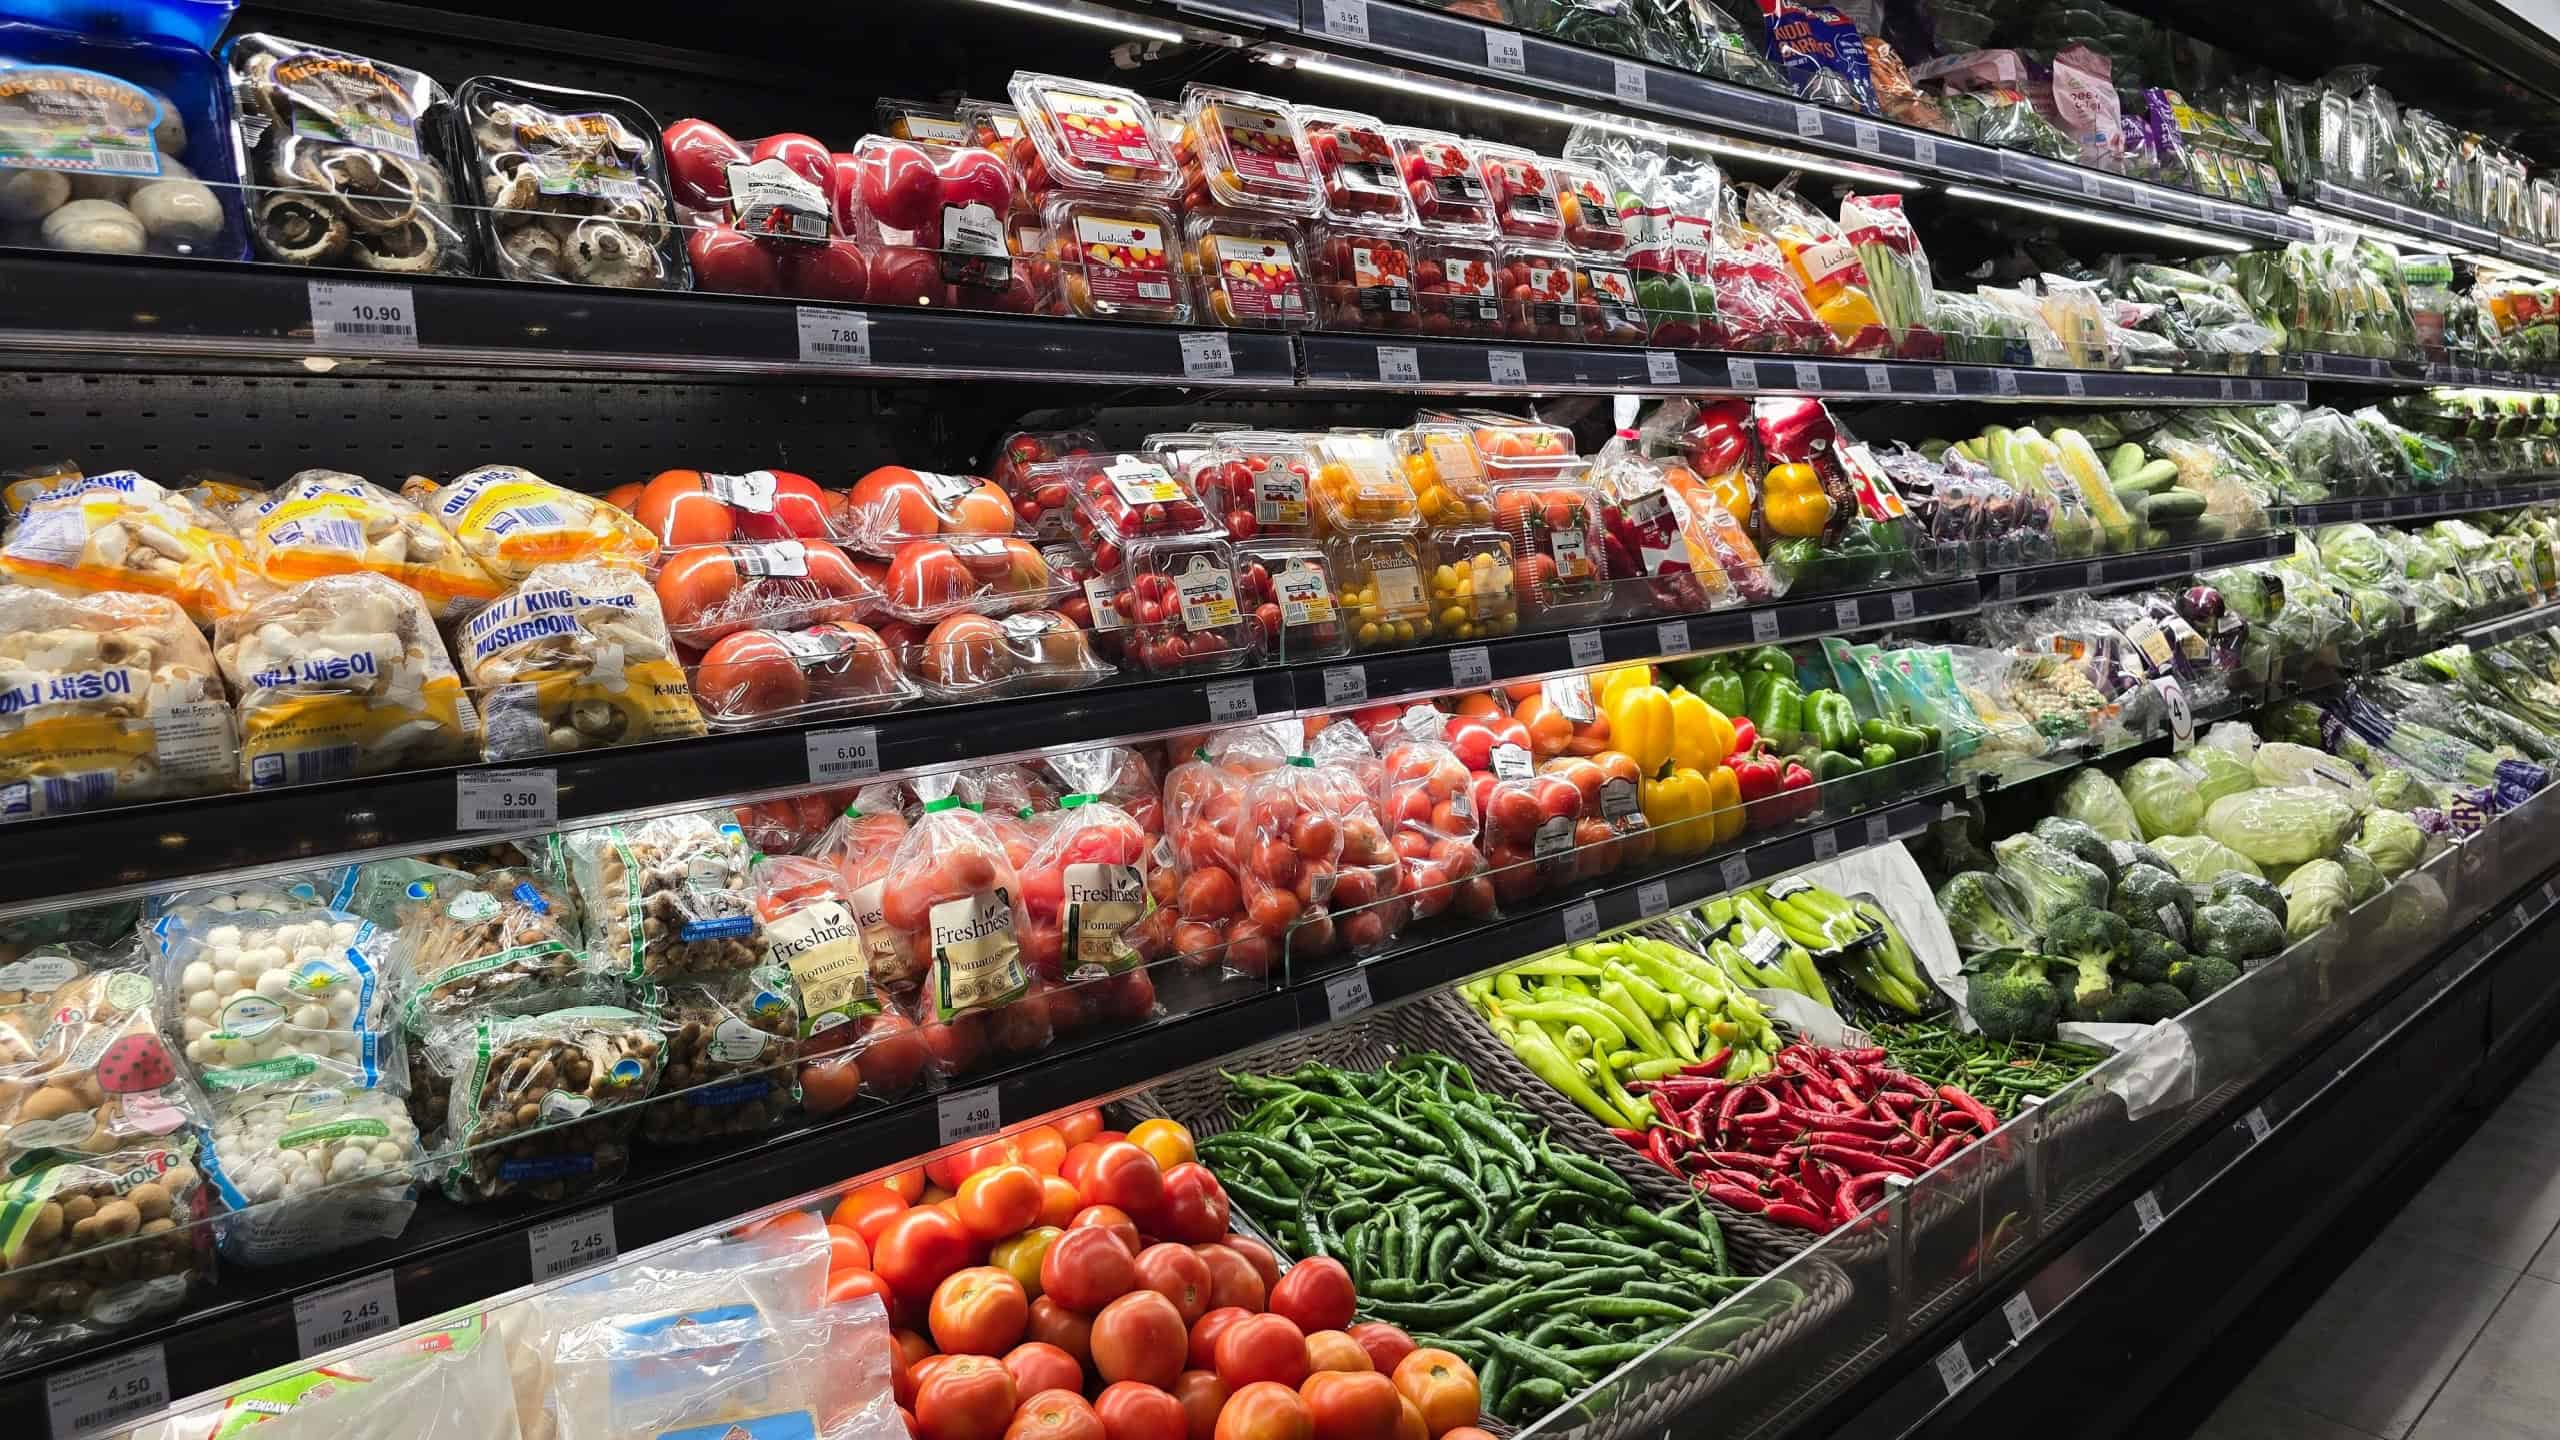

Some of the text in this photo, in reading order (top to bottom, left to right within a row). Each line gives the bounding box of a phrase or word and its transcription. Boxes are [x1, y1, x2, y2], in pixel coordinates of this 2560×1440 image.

[352, 305, 401, 322] 10.90
[831, 328, 859, 343] 7.80
[1203, 349, 1223, 361] 5.99
[1371, 554, 1414, 570] Freshness
[472, 607, 508, 637] MINI
[525, 590, 573, 613] KING
[476, 613, 578, 661] MUSHROOM
[302, 650, 377, 683] 새송이
[49, 668, 132, 701] 새송이
[1229, 698, 1248, 710] 6.85
[2173, 698, 2183, 721] 4
[838, 745, 866, 760] 6.00
[503, 792, 537, 807] 9.50
[1071, 883, 1141, 904] Freshness
[935, 910, 1011, 947] Freshness
[771, 922, 858, 964] Freshness
[967, 1107, 990, 1123] 4.90
[114, 1150, 181, 1196] HOKTO
[570, 1232, 603, 1254] 2.45
[342, 1300, 379, 1325] 2.45
[107, 1375, 151, 1401] 4.50
